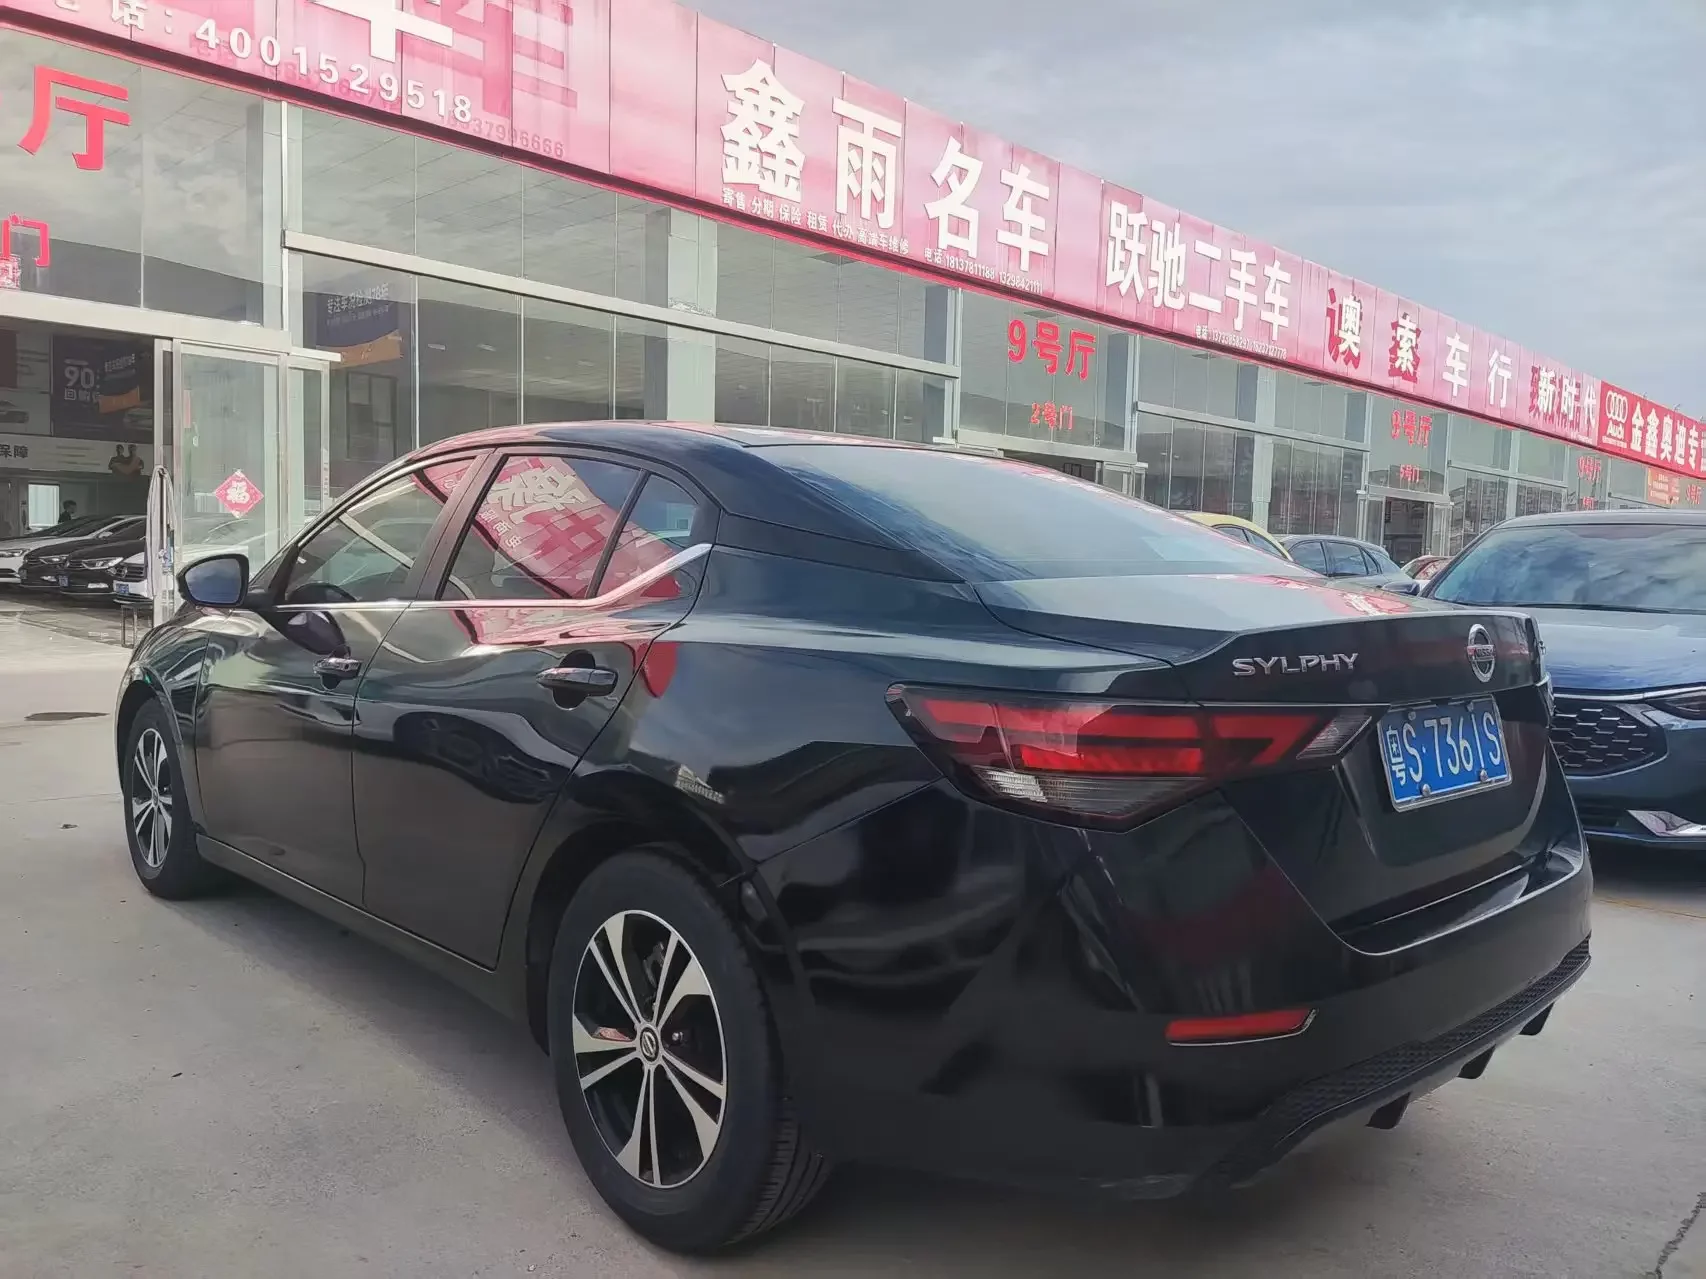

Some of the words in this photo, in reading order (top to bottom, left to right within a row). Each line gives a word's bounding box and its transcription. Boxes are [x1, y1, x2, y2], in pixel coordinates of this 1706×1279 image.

[17, 65, 132, 171] 厅
[720, 58, 1050, 272] 鑫雨名车
[723, 187, 747, 211] 寄售
[751, 197, 775, 219] 分期
[778, 203, 802, 226] 保险
[806, 210, 829, 233] 租赁
[832, 216, 854, 240] 代办
[857, 227, 910, 256] 高端车维修
[924, 247, 942, 264] 电话
[1106, 200, 1292, 341] 跃驰二手车
[64, 366, 95, 389] 90
[1007, 319, 1096, 381] 9号厅
[1390, 409, 1433, 448] 9号厅
[1537, 366, 1597, 429] 新时代
[1606, 420, 1625, 440] Audi
[226, 480, 251, 505] 福
[1232, 653, 1359, 676] SYLPHY
[1386, 711, 1502, 787] 粤S·7361S
